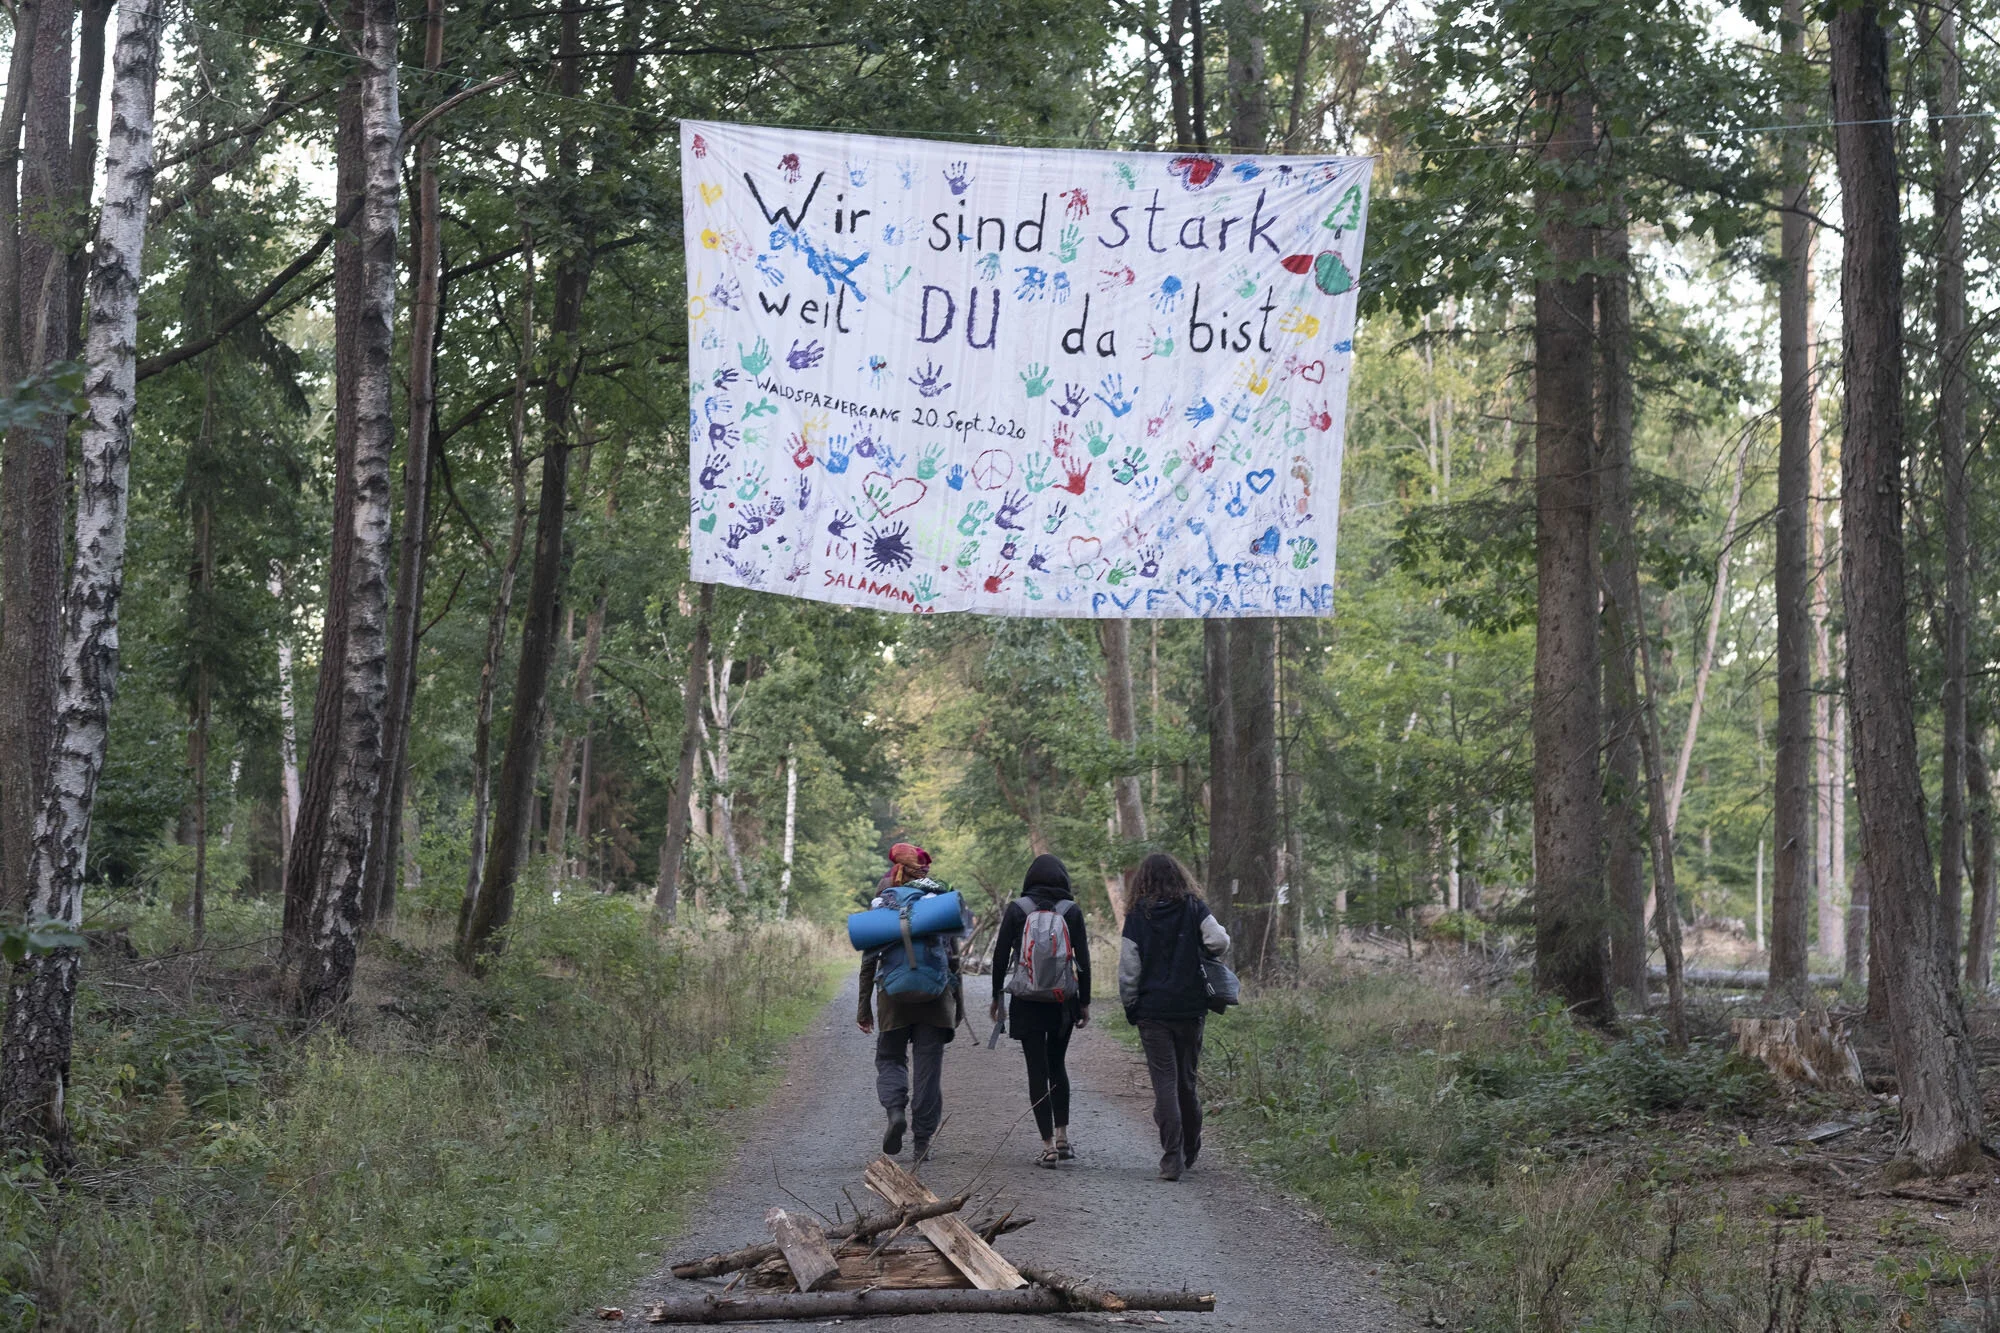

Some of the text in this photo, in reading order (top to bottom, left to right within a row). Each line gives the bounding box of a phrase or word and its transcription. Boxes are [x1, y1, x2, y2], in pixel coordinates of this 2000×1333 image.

[743, 171, 1280, 254] Wir sind stark
[758, 282, 1278, 357] weil DU da bist
